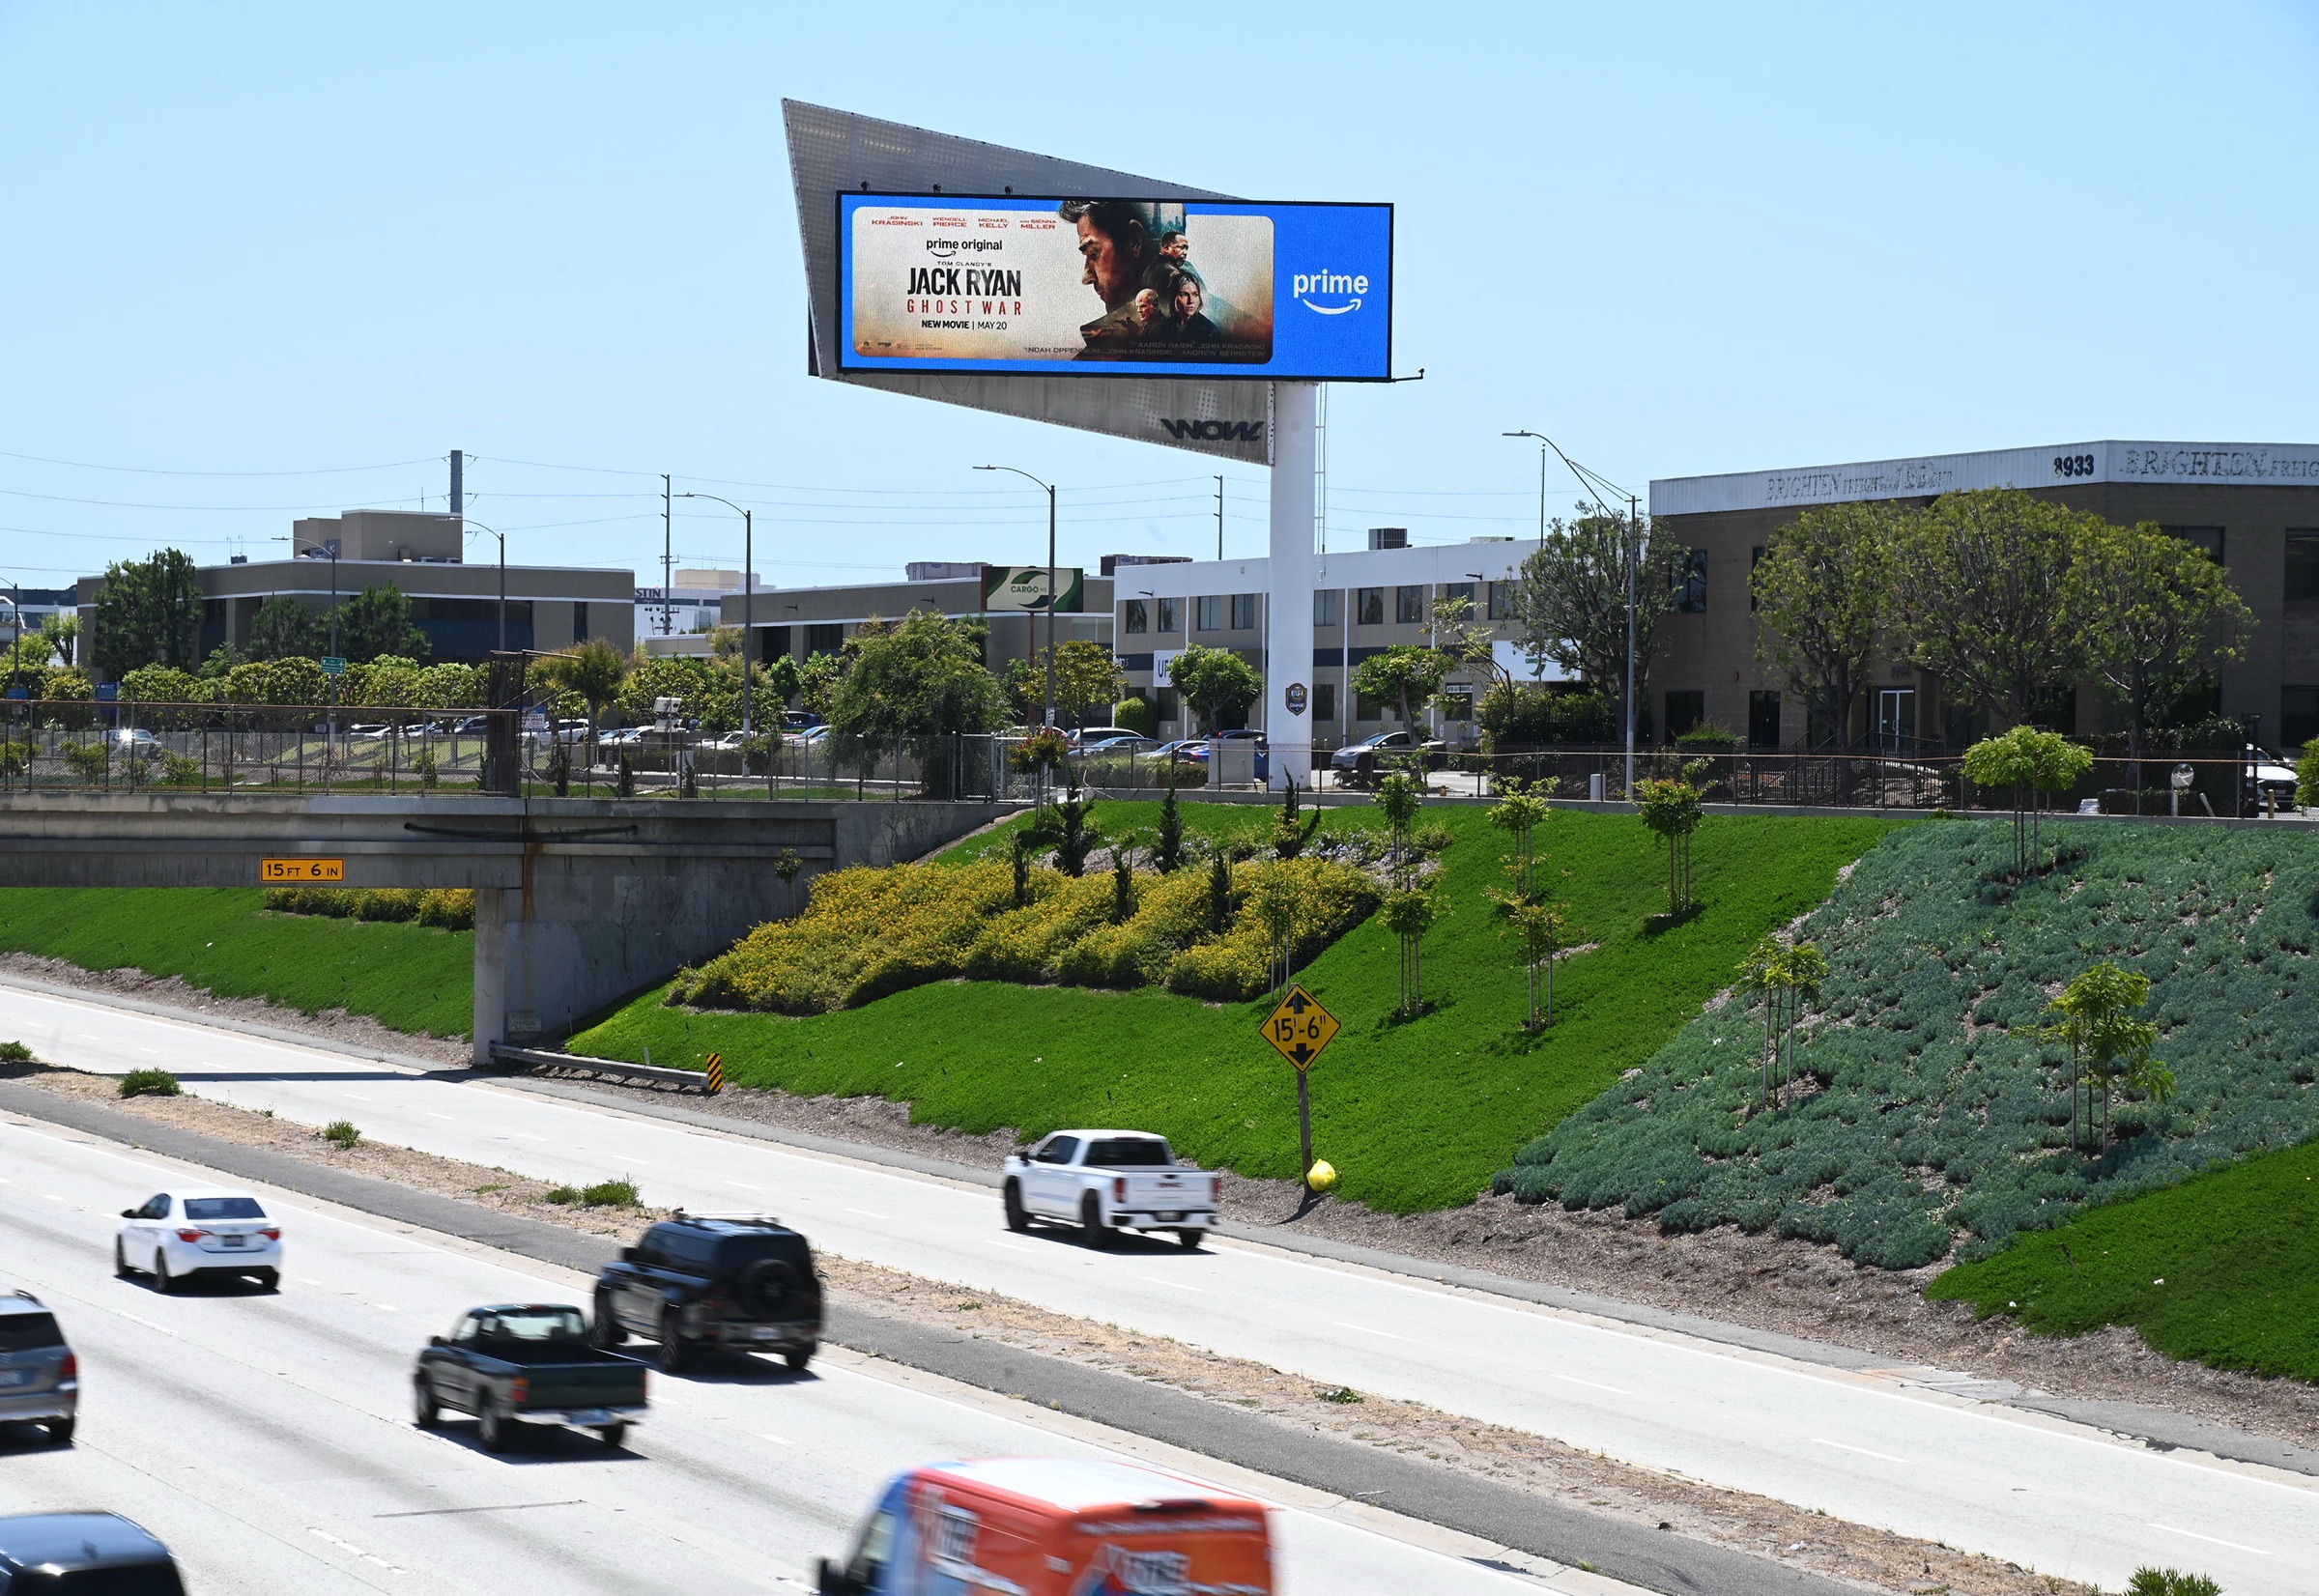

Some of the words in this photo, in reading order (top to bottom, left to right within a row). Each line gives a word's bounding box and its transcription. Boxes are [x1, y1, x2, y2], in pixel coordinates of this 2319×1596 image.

[927, 238, 959, 251] prime
[961, 239, 1003, 251] original
[907, 268, 961, 296] JACK
[966, 269, 1021, 297] RYAN
[1293, 269, 1368, 299] prime
[907, 299, 972, 314] GHOST
[982, 300, 1021, 315] WAR
[922, 320, 941, 328] NEW
[942, 321, 969, 329] MOVIE
[978, 321, 995, 329] MAY
[996, 322, 1008, 330] 20
[2053, 454, 2094, 478] 8933
[2126, 450, 2268, 476] BRIGHTEN
[1766, 472, 1842, 500] BRIGHTEN
[267, 863, 284, 876] 15
[287, 868, 301, 876] FT
[311, 863, 322, 876] 6
[327, 868, 338, 876] IN
